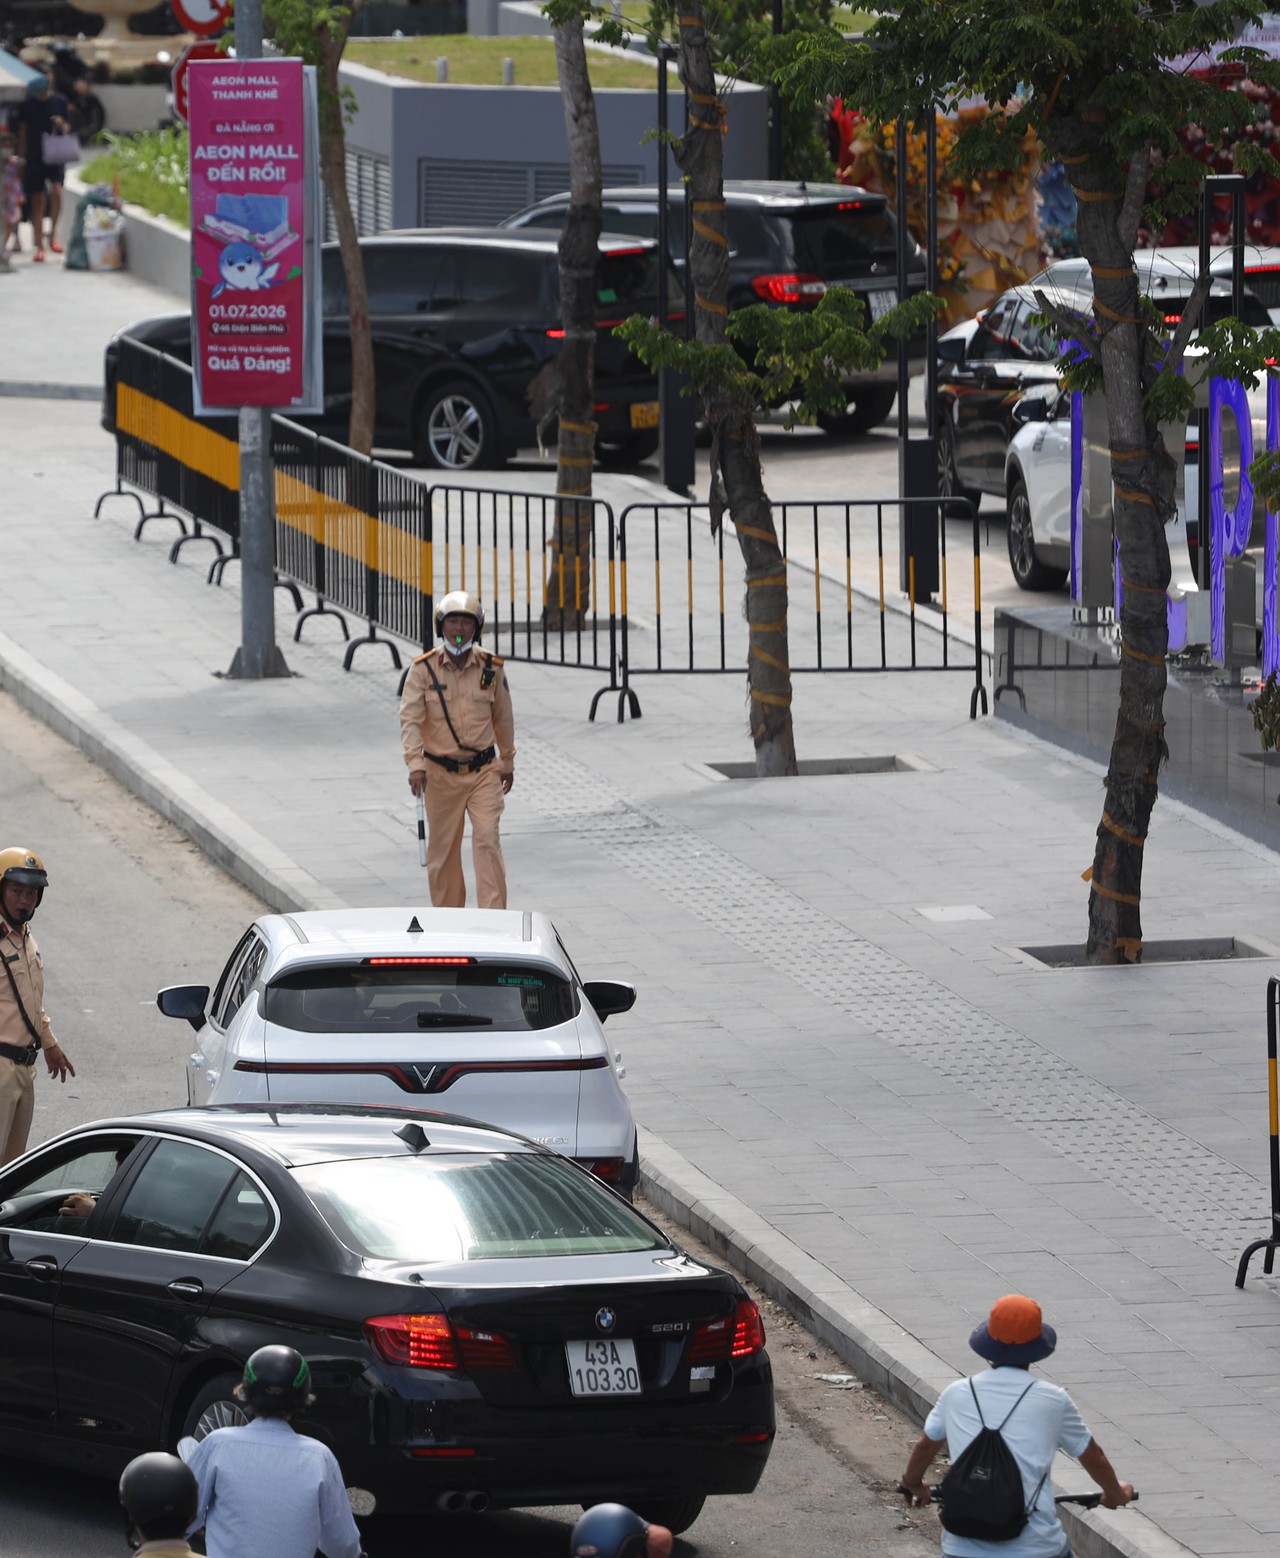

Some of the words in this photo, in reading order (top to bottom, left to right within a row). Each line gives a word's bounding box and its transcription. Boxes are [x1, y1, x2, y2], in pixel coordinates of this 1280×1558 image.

[212, 76, 245, 85] AEON
[247, 76, 279, 85] MALL
[211, 90, 253, 99] THANH
[255, 88, 278, 99] KHÊ
[216, 122, 231, 132] ĐÀ
[194, 145, 245, 159] AEON
[249, 144, 299, 159] MALL
[207, 161, 245, 181] ĐẾN
[249, 160, 286, 181] RỒI!
[208, 304, 287, 318] 01.07.2026
[207, 355, 240, 371] Quá
[243, 355, 291, 374] Đáng!
[585, 1341, 622, 1366] 43A
[575, 1367, 639, 1393] 103.30
